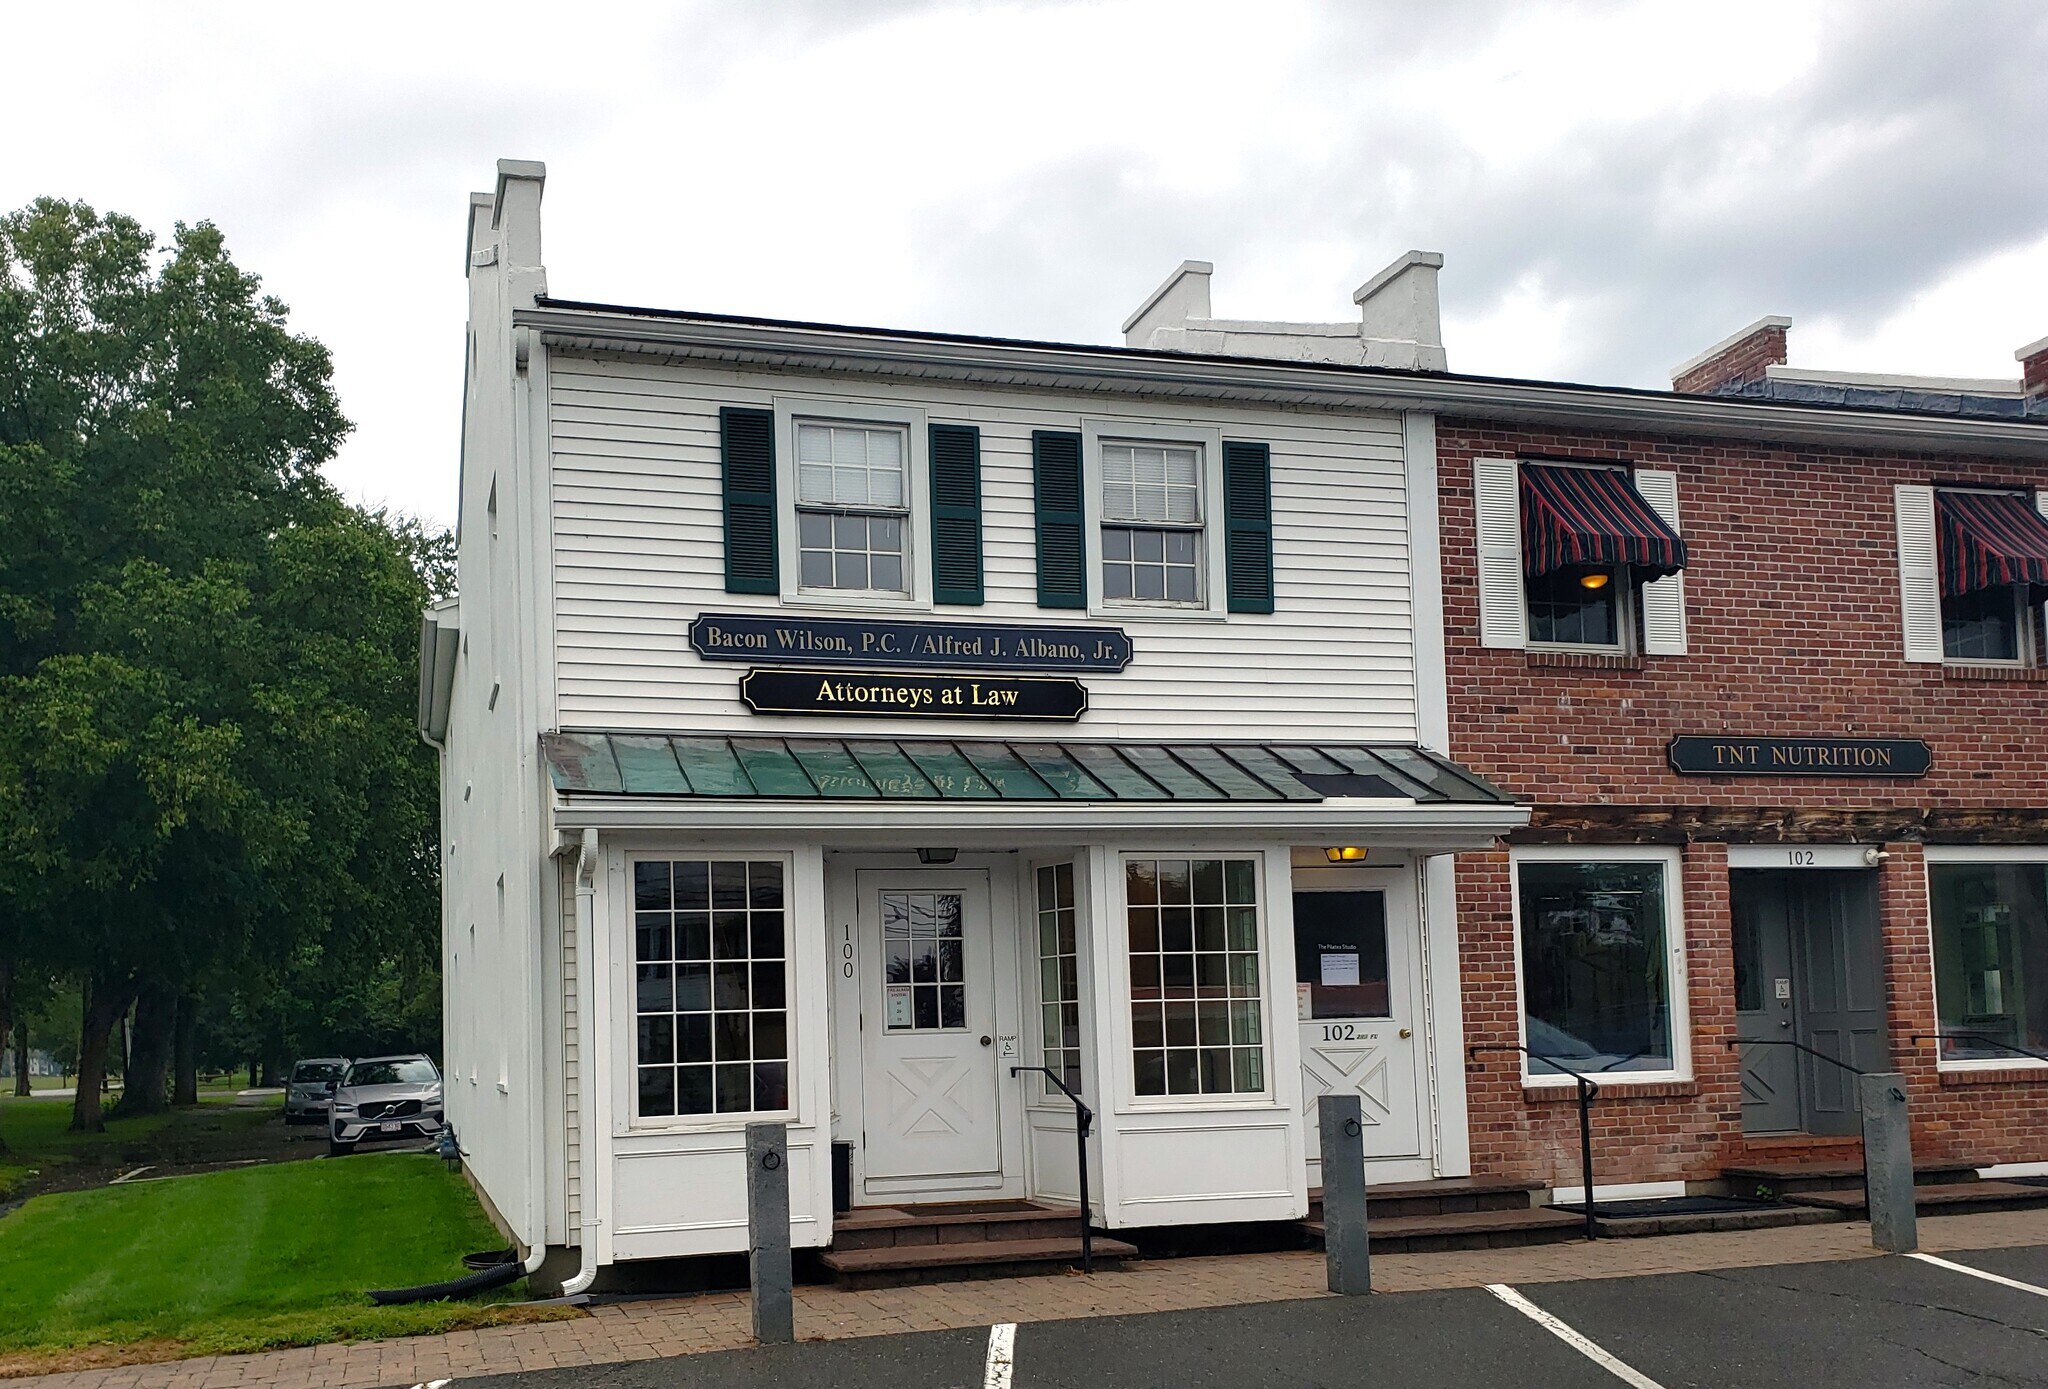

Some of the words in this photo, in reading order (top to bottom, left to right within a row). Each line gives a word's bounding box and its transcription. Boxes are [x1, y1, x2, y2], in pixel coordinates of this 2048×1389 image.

[707, 626, 767, 648] Bacon
[775, 628, 853, 655] Wilson,
[861, 632, 901, 653] P.C.
[990, 637, 1007, 656] J.
[1015, 638, 1085, 662] Albano,
[1093, 640, 1118, 660] Jr.
[816, 679, 933, 708] Attorneys
[941, 685, 963, 705] at
[971, 684, 1019, 706] Law
[1713, 745, 1759, 765] TNT
[1770, 746, 1892, 766] NUTRITION
[1789, 850, 1814, 865] 102
[843, 924, 853, 978] 100
[1322, 1024, 1355, 1041] 102
